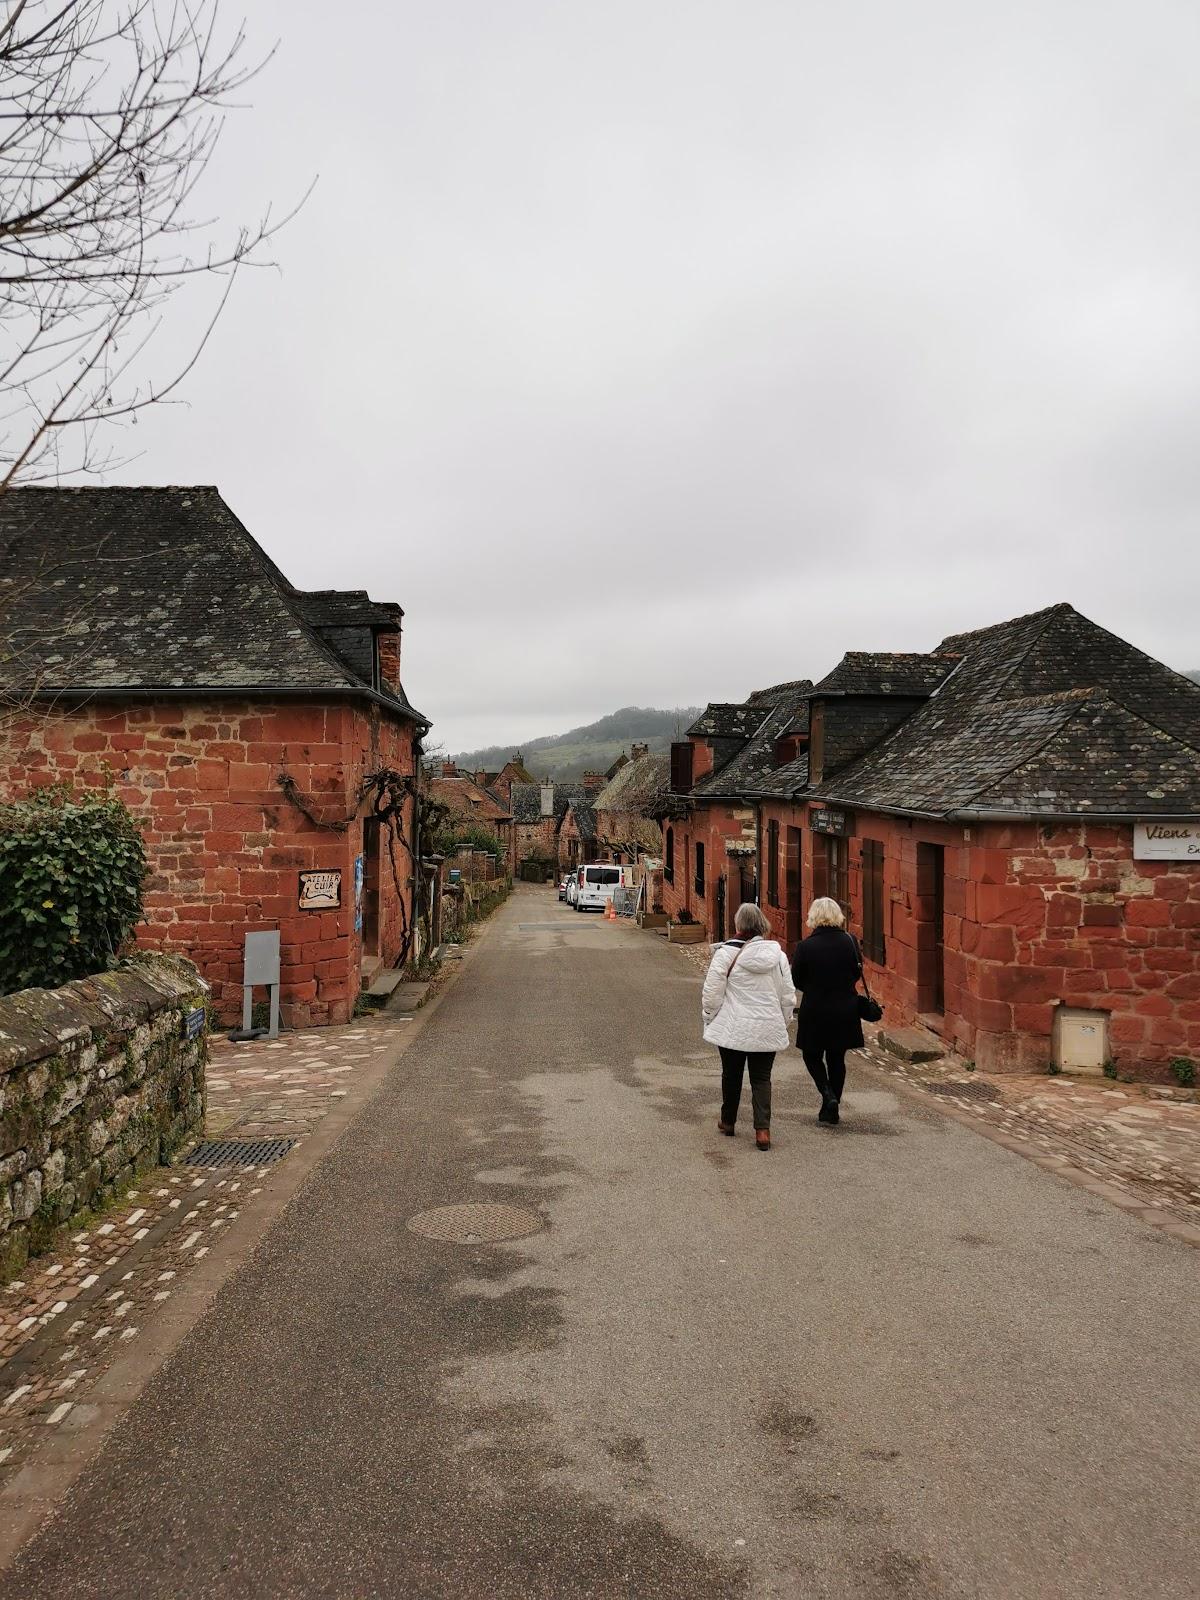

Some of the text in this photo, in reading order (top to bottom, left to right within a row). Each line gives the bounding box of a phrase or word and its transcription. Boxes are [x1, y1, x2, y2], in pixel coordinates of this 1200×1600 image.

[1146, 825, 1191, 840] Viens
[306, 874, 340, 883] ATELIER
[314, 881, 334, 890] CUIR
